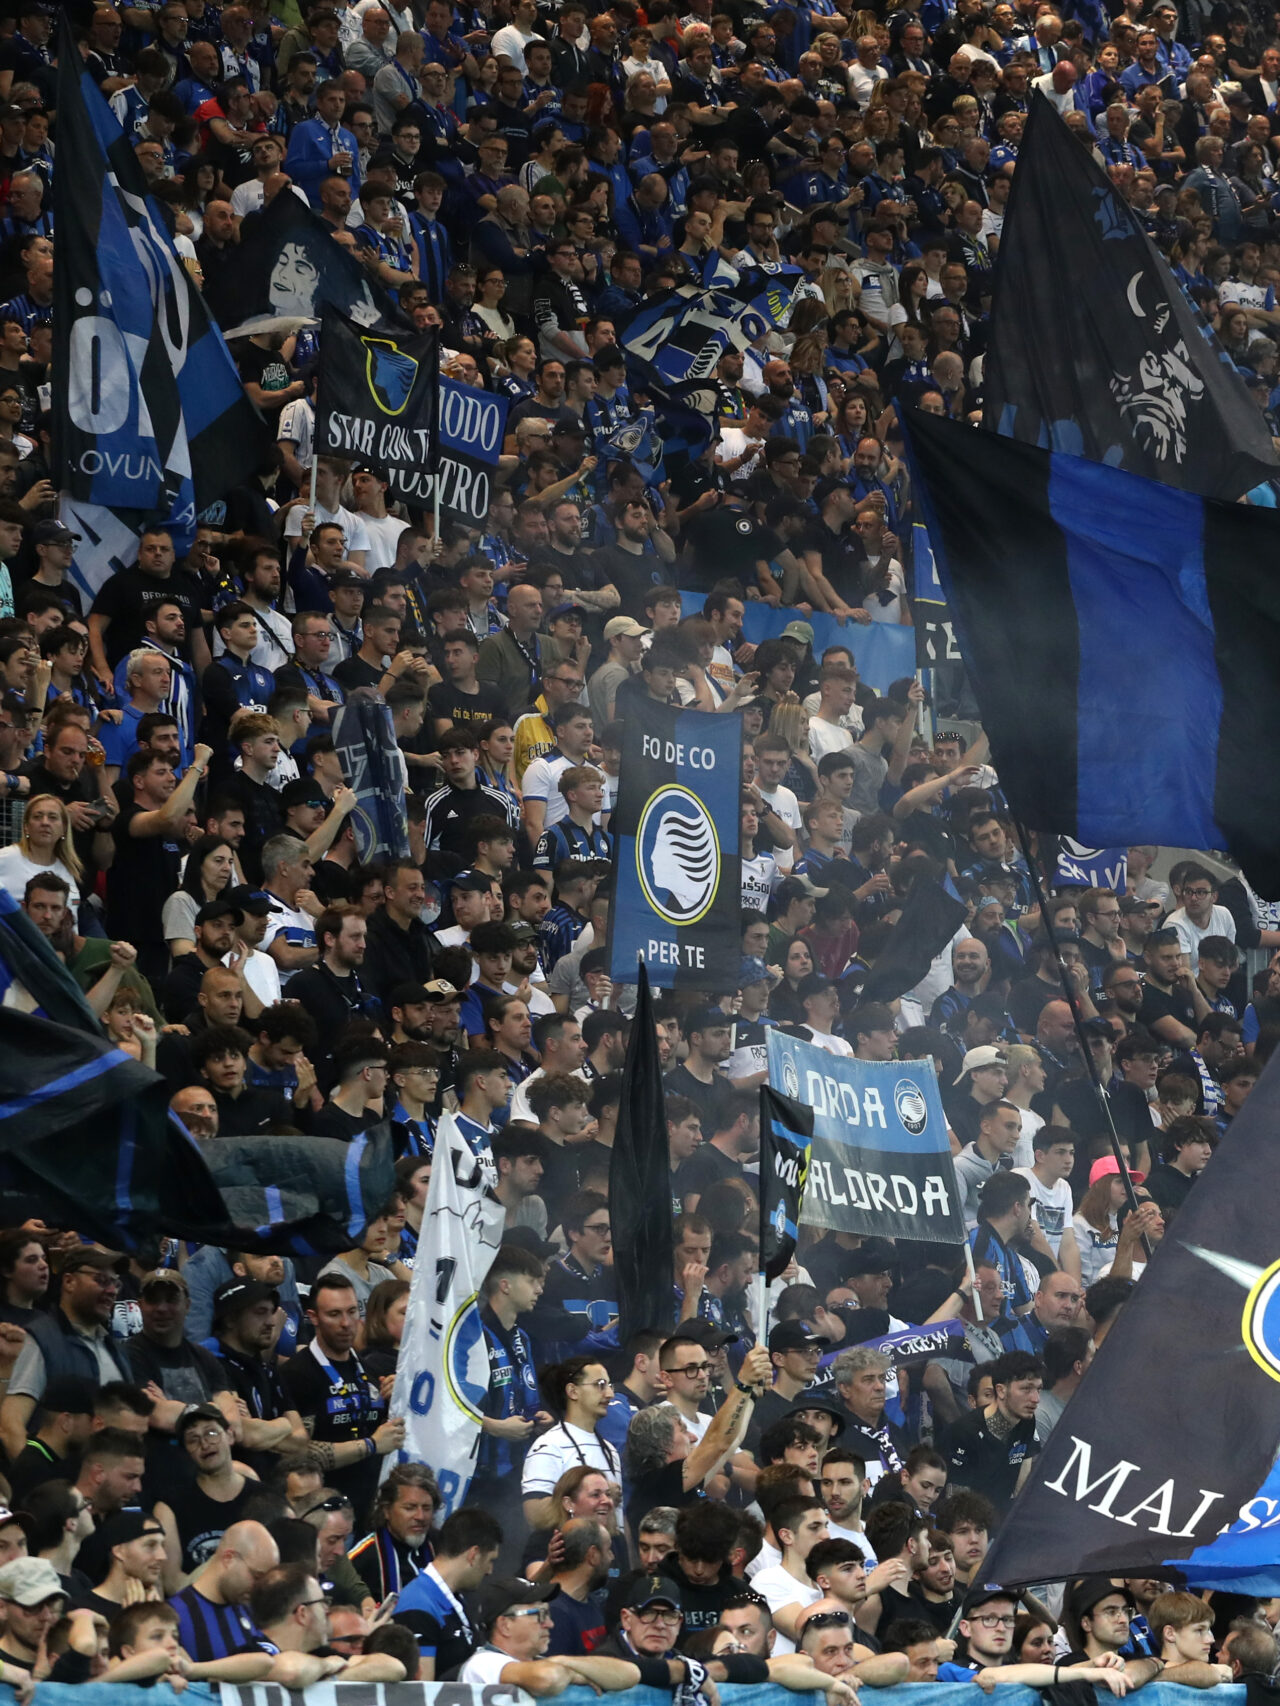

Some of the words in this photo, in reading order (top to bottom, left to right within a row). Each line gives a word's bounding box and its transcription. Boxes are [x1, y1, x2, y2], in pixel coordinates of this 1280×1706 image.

[328, 411, 376, 456] STAR
[379, 423, 415, 463] CON
[642, 734, 660, 759] FO
[665, 741, 684, 766] DE
[689, 748, 716, 770] CO
[648, 939, 680, 965] PER
[684, 944, 705, 969] TE
[803, 1159, 950, 1216] ALORDA
